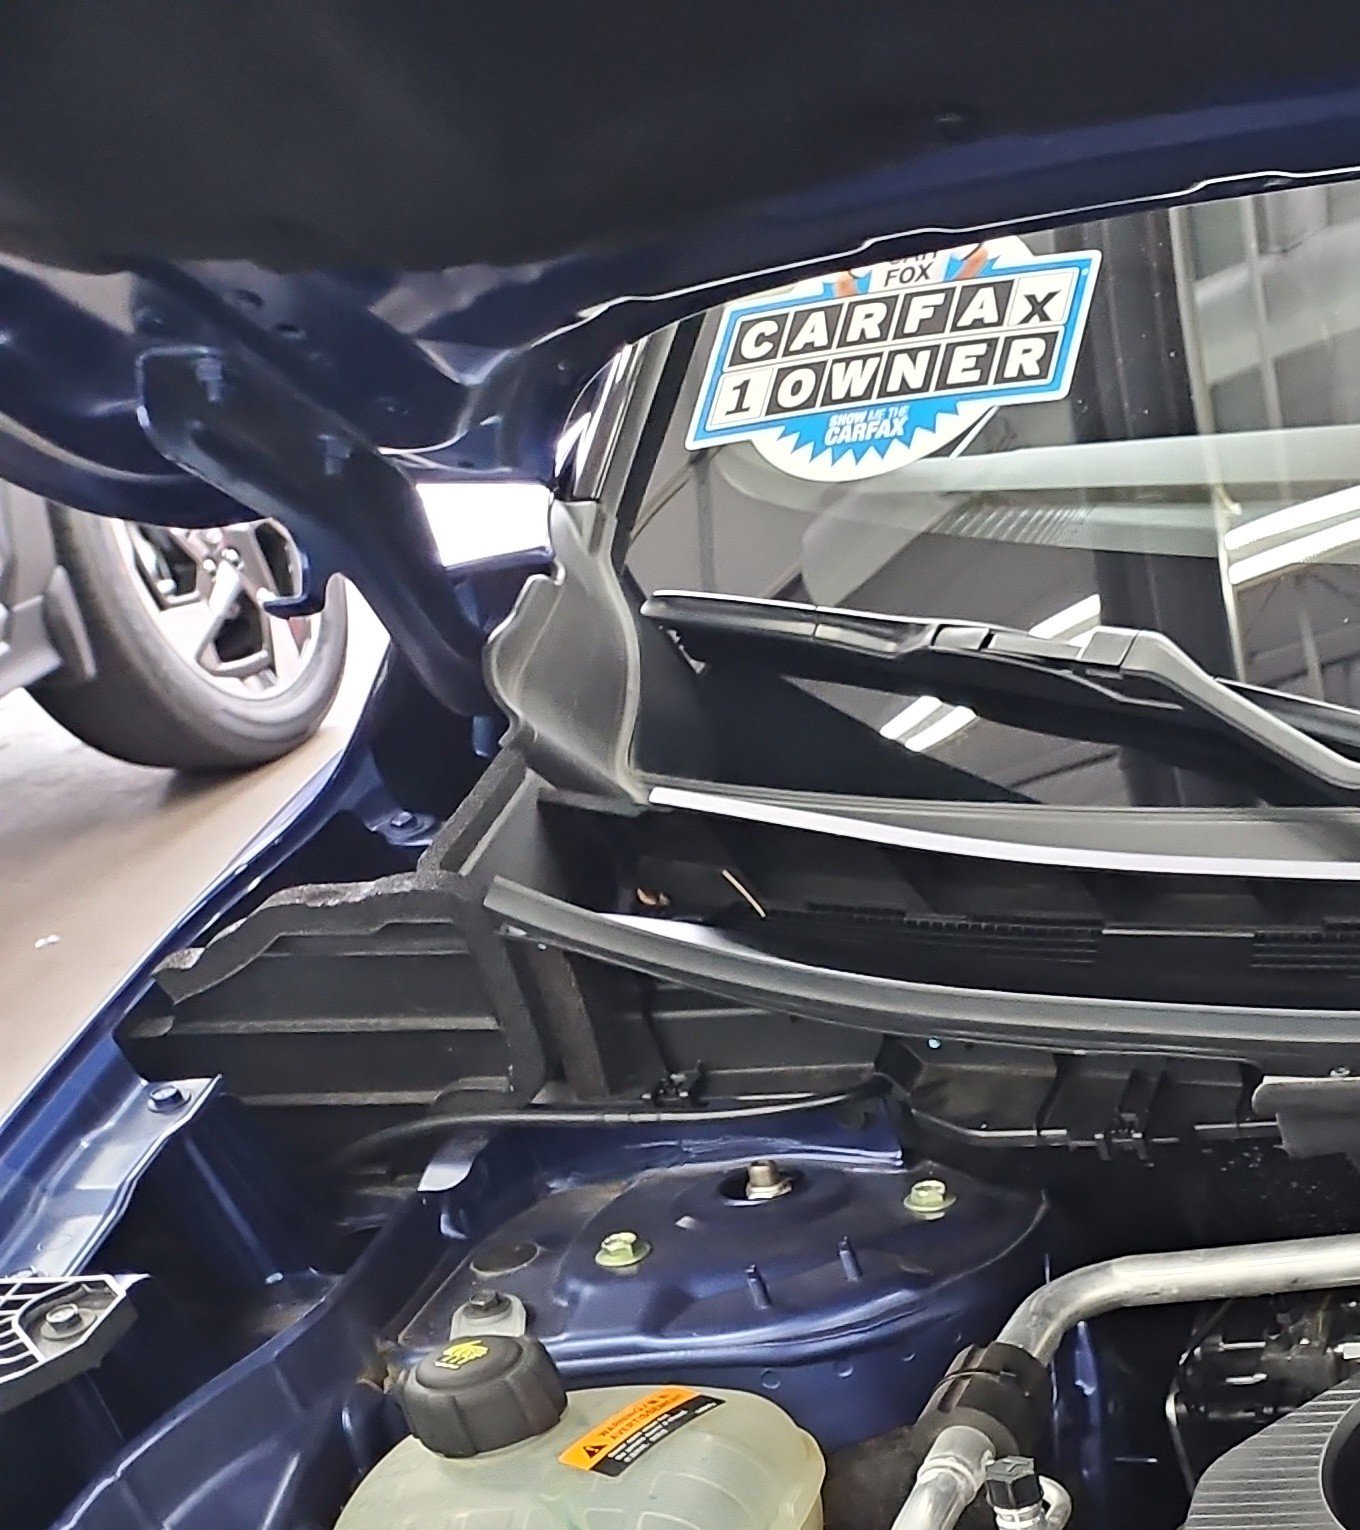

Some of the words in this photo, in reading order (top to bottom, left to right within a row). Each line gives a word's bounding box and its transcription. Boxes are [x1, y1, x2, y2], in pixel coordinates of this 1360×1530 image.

[884, 262, 934, 287] FOX
[739, 286, 1058, 361] CARFAX
[824, 416, 909, 446] CARFAX
